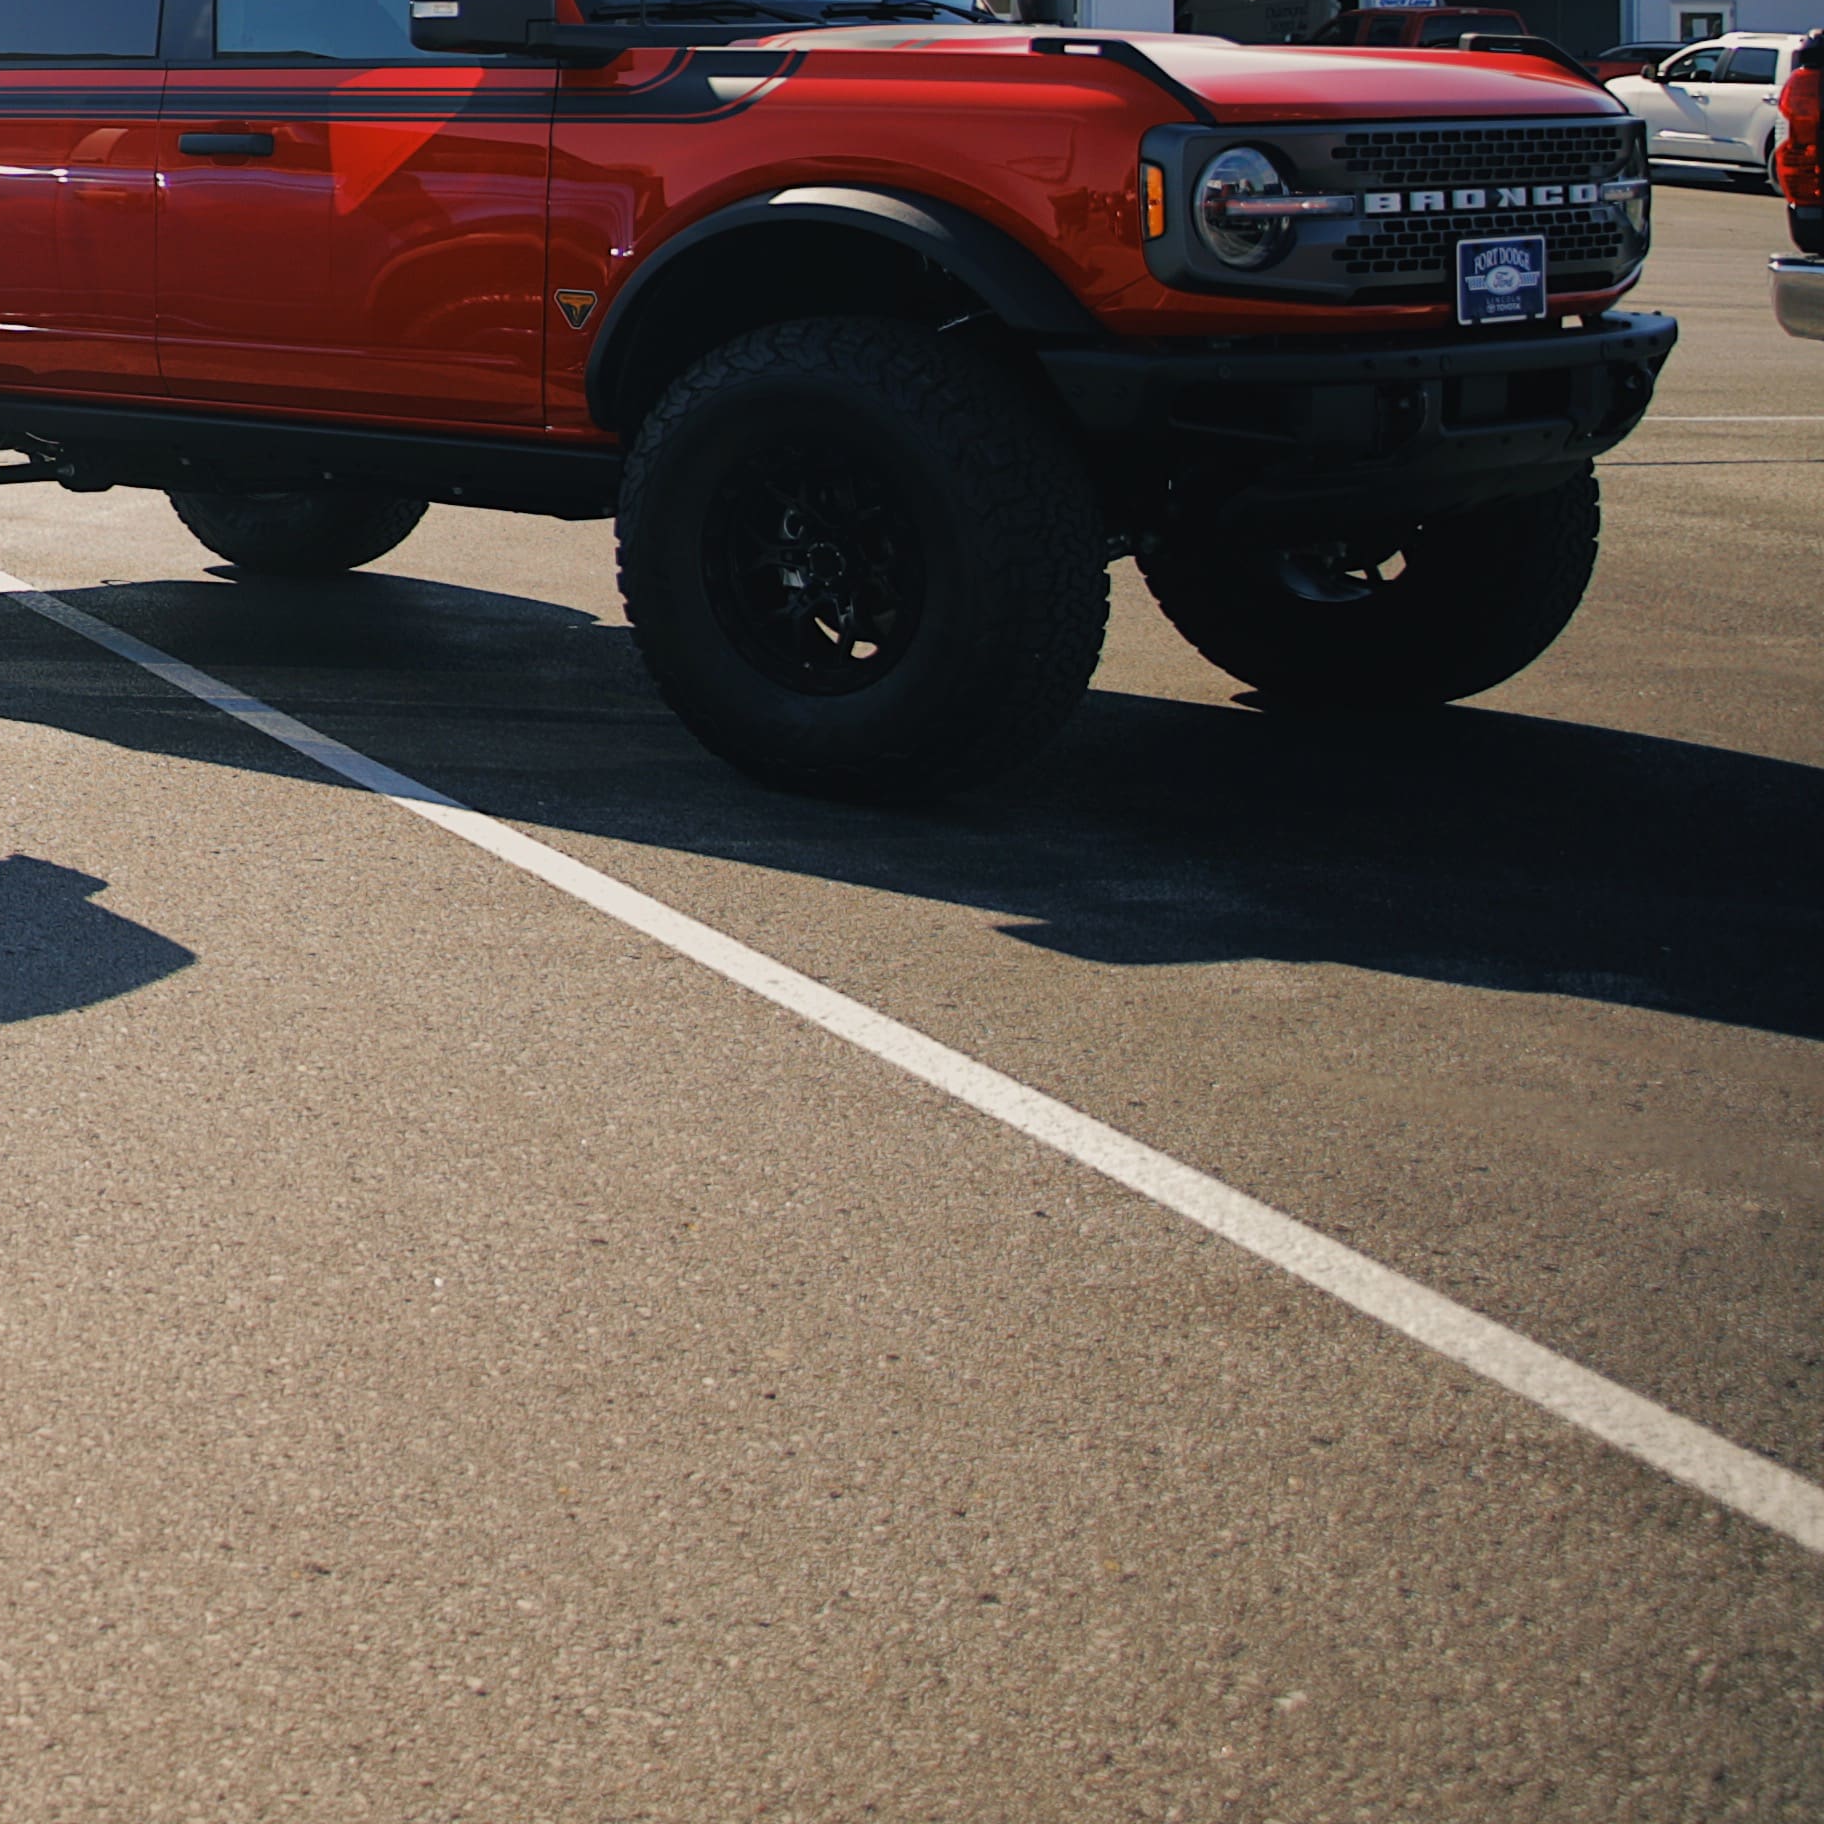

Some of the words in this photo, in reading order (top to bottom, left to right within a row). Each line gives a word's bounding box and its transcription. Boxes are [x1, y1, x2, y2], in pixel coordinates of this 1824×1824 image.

[1363, 183, 1598, 214] BRONCO
[1474, 247, 1499, 275] FORT
[1499, 246, 1531, 271] DODGE
